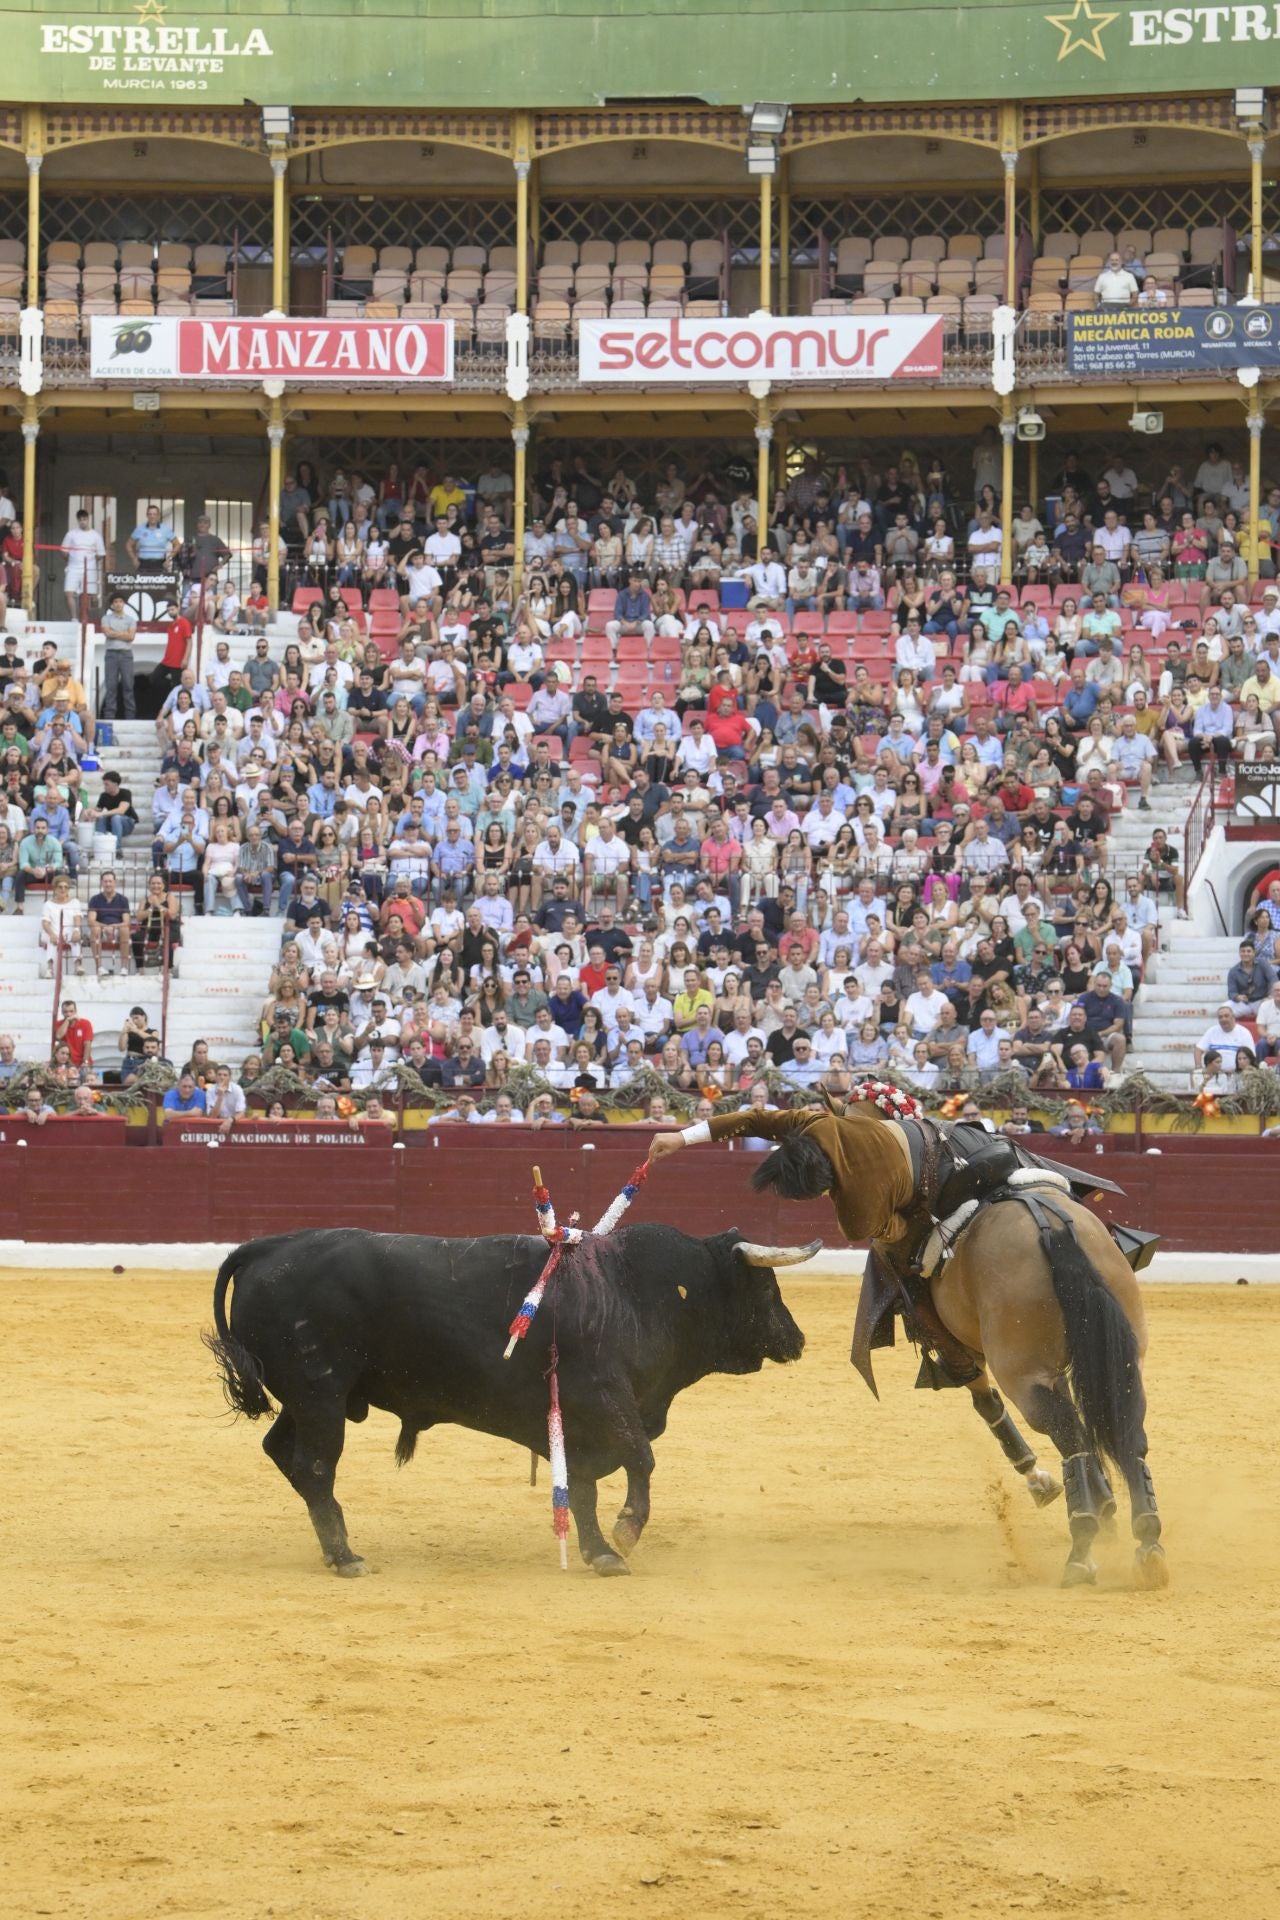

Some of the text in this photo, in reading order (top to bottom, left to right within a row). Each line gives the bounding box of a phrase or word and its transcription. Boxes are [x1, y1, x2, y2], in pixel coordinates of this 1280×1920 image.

[1129, 5, 1280, 47] ESTR
[40, 25, 273, 56] ESTRELLA
[88, 56, 224, 74] DE LEVANTE
[103, 78, 208, 91] MURCIA 1963
[1073, 311, 1181, 327] NEUMÁTICOS Y
[1073, 326, 1195, 341] MECÁNICA RODA
[200, 321, 428, 376] MANZANO
[599, 319, 889, 370] setcomur
[1073, 344, 1084, 352] Av.
[1086, 344, 1095, 352] de
[1142, 342, 1150, 350] 11
[1096, 353, 1123, 361] Cabezo
[1125, 352, 1134, 360] de
[1136, 351, 1159, 359] Torres
[1160, 350, 1195, 359] (MURCIA)
[95, 367, 172, 375] ACEITES DE OLIVA
[902, 365, 938, 373] SHARP
[180, 1133, 365, 1143] CUERPO NACIONAL DE POLICIA
[432, 1136, 440, 1147] 1
[1095, 1143, 1104, 1155] 2
